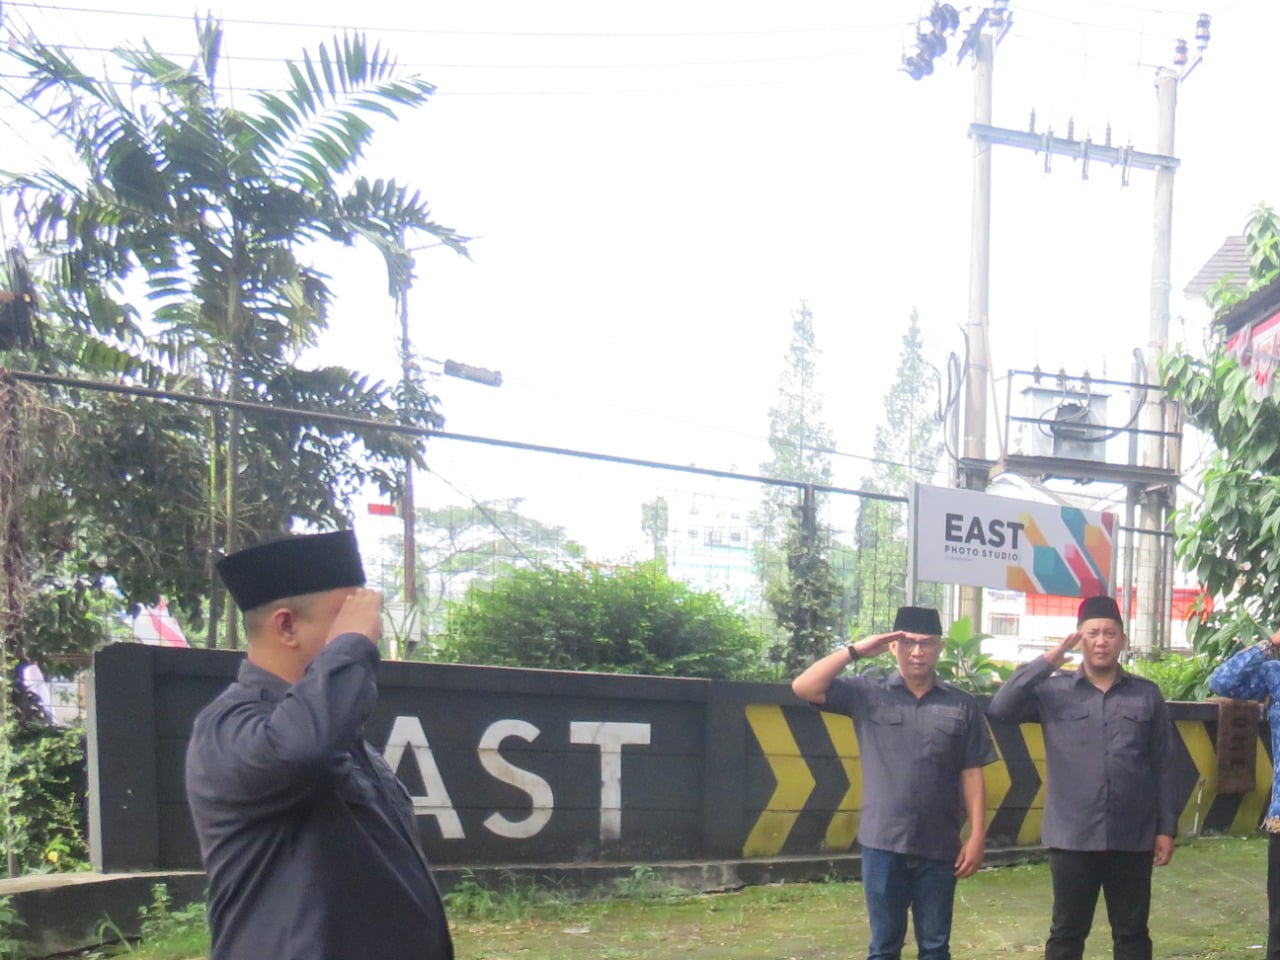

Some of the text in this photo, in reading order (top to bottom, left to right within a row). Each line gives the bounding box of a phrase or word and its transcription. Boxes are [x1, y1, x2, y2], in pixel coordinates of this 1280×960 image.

[945, 512, 1025, 550] EAST
[944, 545, 979, 557] PHOTO
[982, 551, 1018, 562] STUDIO
